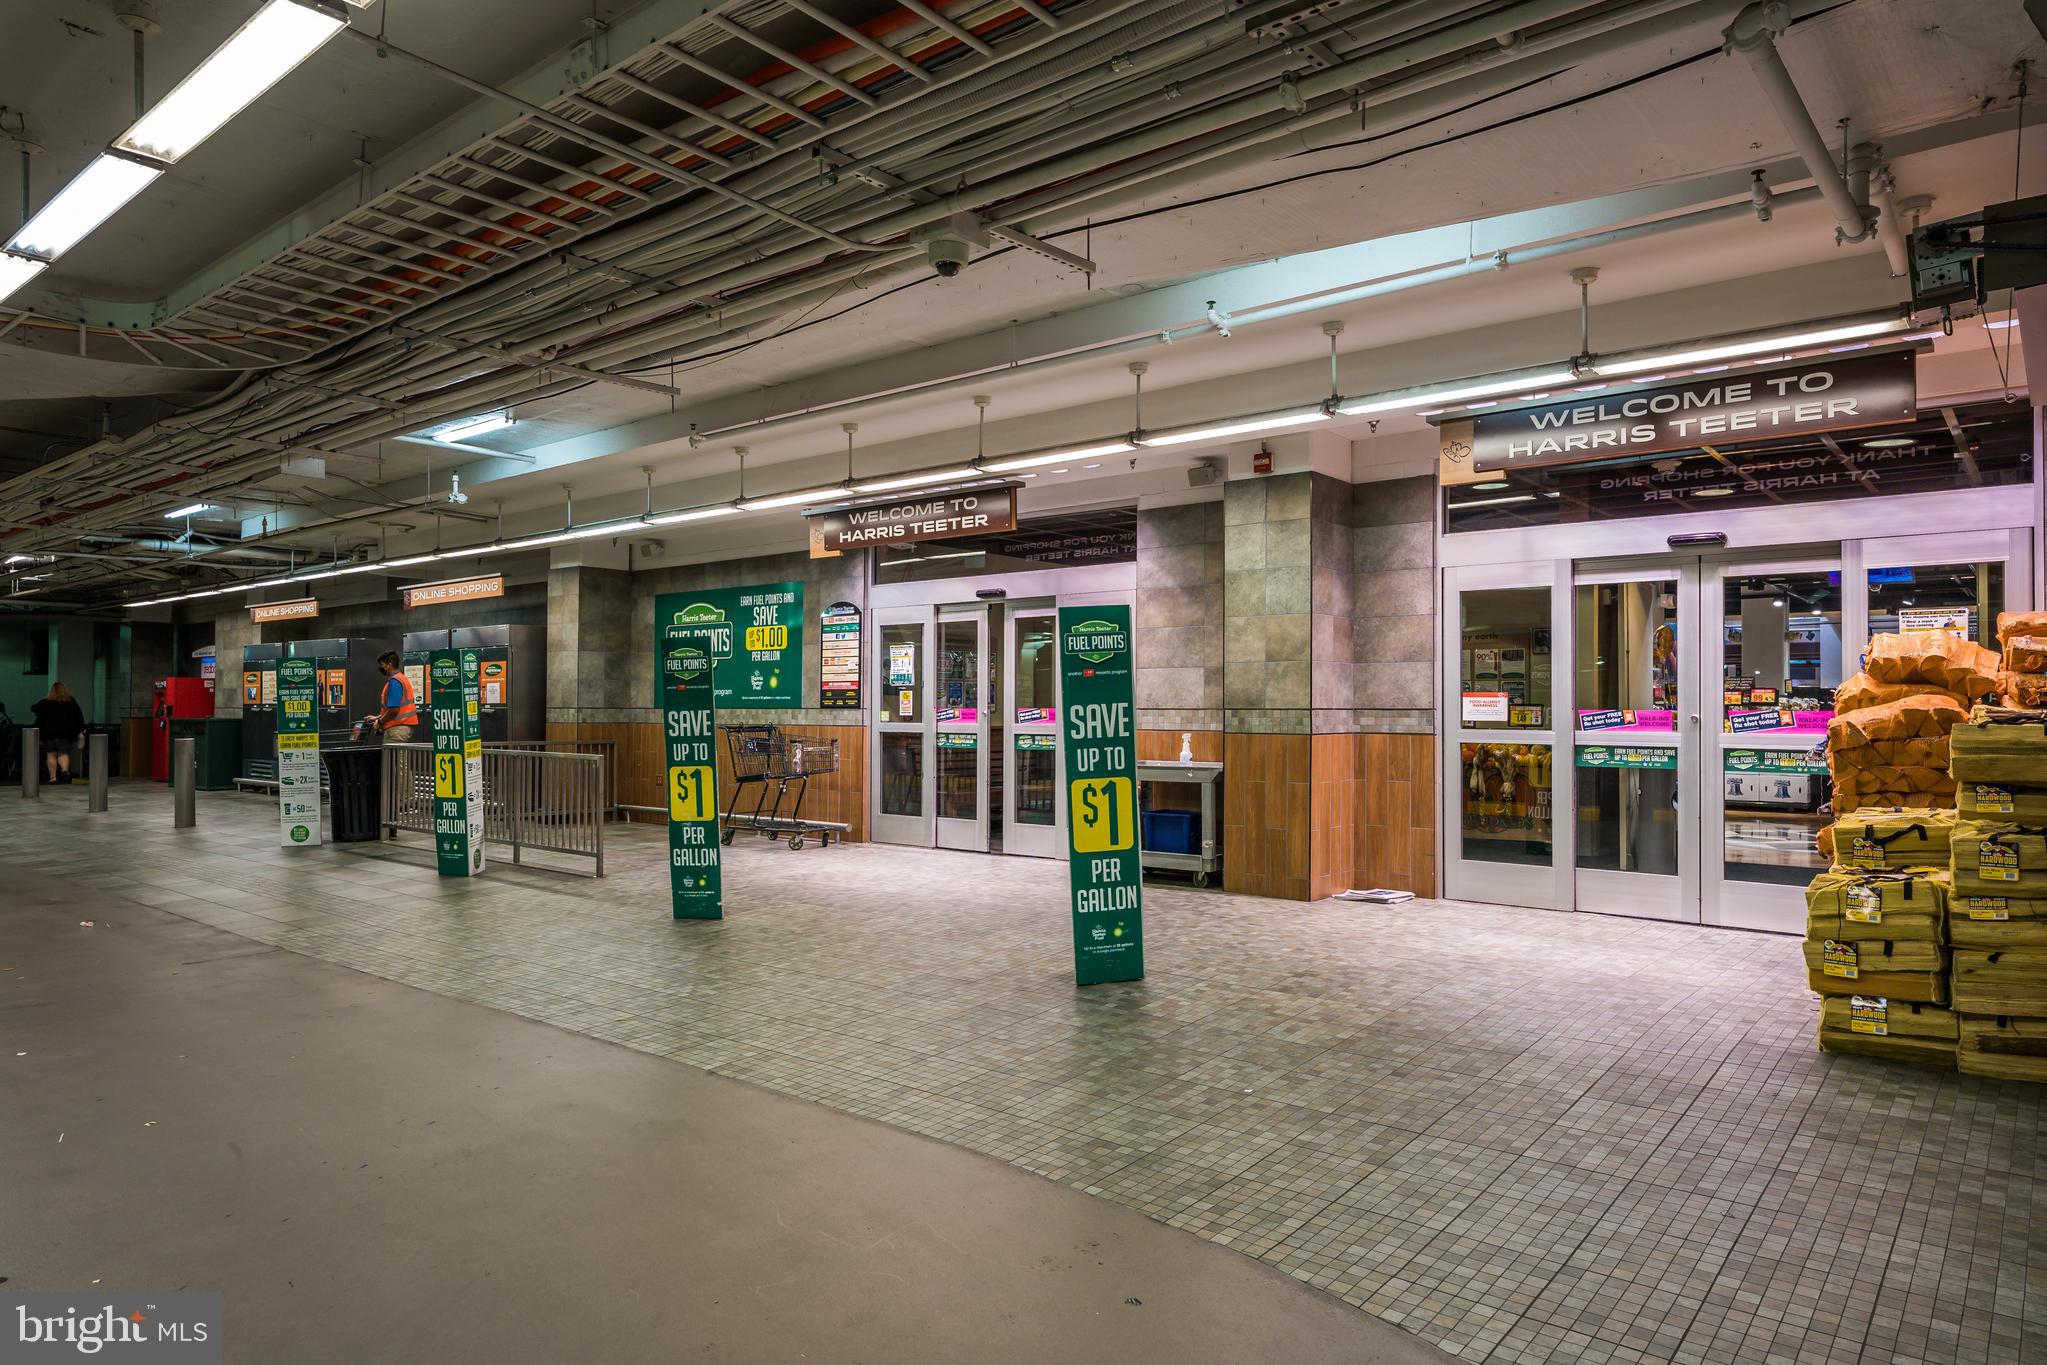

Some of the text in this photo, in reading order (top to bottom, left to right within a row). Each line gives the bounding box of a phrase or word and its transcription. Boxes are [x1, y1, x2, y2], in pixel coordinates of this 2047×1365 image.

[1529, 371, 1834, 431] WELCOME TO
[1508, 397, 1860, 458] HARRIS TEETER
[849, 497, 978, 525] WELCOME TO
[839, 514, 988, 544] HARRIS TEETER
[412, 581, 499, 601] ONLINE SHOPPING
[740, 592, 795, 606] EARN FUEL POINTS AND
[256, 604, 314, 618] ONLINE SHOPPING
[682, 613, 717, 623] Harris Teeter
[753, 605, 778, 626] SAVE
[756, 627, 783, 648] $1.00
[1068, 634, 1124, 651] FUEL POINTS
[1475, 632, 1498, 640] earth
[667, 658, 707, 671] FUEL POINTS
[752, 651, 780, 661] PER GALLON
[281, 667, 313, 676] FUEL POINTS
[433, 667, 458, 677] FUEL POINTS
[287, 701, 307, 712] $1.00
[433, 709, 461, 730] SAVE
[668, 709, 711, 737] SAVE
[1070, 702, 1129, 740] SAVE
[437, 735, 447, 750] UP
[449, 735, 459, 750] TO
[673, 743, 708, 761] UP TO
[1077, 746, 1125, 771] UP TO
[440, 755, 456, 795] $1
[677, 768, 703, 817] $1
[443, 802, 458, 816] PER
[1082, 780, 1119, 846] $1
[436, 819, 466, 834] GALLON
[683, 827, 705, 845] PER
[673, 848, 717, 866] GALLON
[1853, 849, 1885, 858] HARDWOOD
[1980, 855, 2017, 865] HARDWOOD
[1091, 858, 1121, 883] PER
[1077, 885, 1138, 913] GALLON
[1846, 898, 1880, 908] HARDWOOD
[1824, 952, 1857, 964] HARDWOOD
[1851, 1009, 1886, 1020] HARDWOOD
